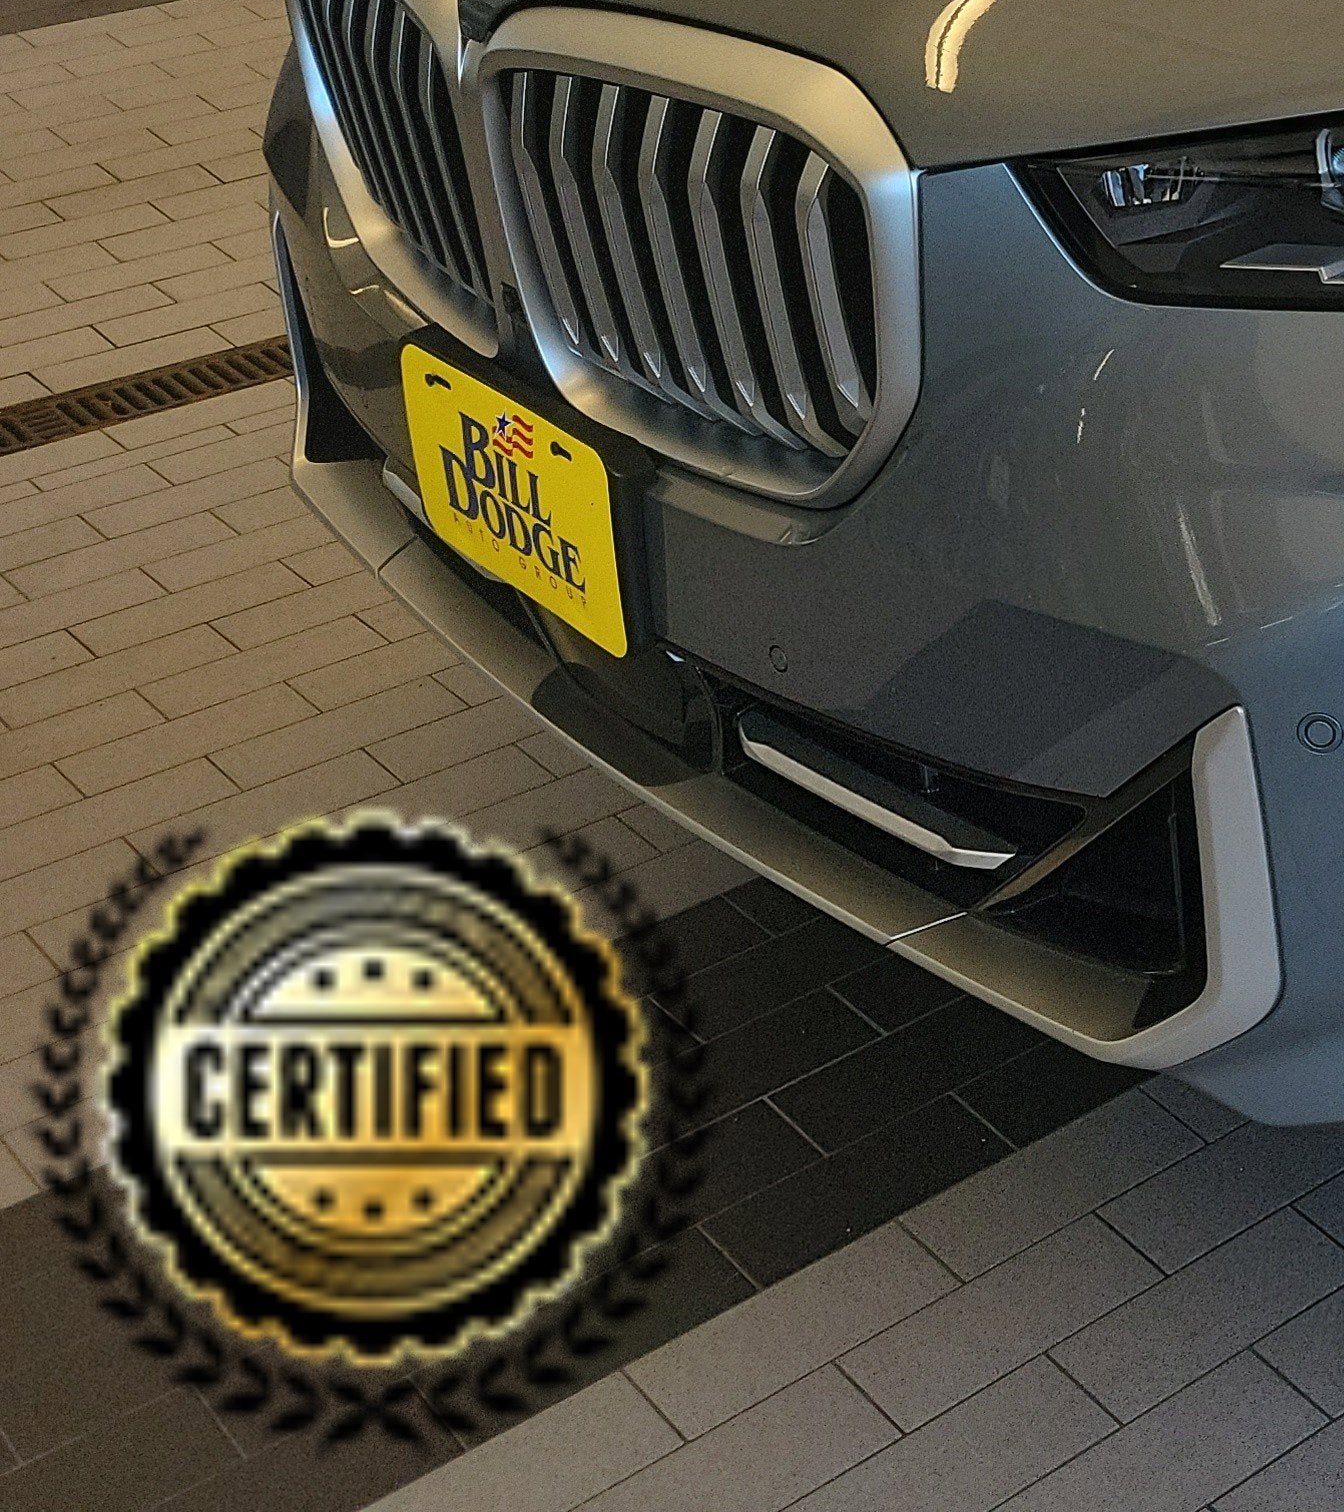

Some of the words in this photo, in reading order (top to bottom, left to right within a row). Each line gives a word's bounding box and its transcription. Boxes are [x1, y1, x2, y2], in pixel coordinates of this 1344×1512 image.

[439, 444, 586, 595] DODGE
[458, 411, 553, 527] BILL
[453, 511, 500, 553] AUTO
[518, 555, 587, 608] GROUP
